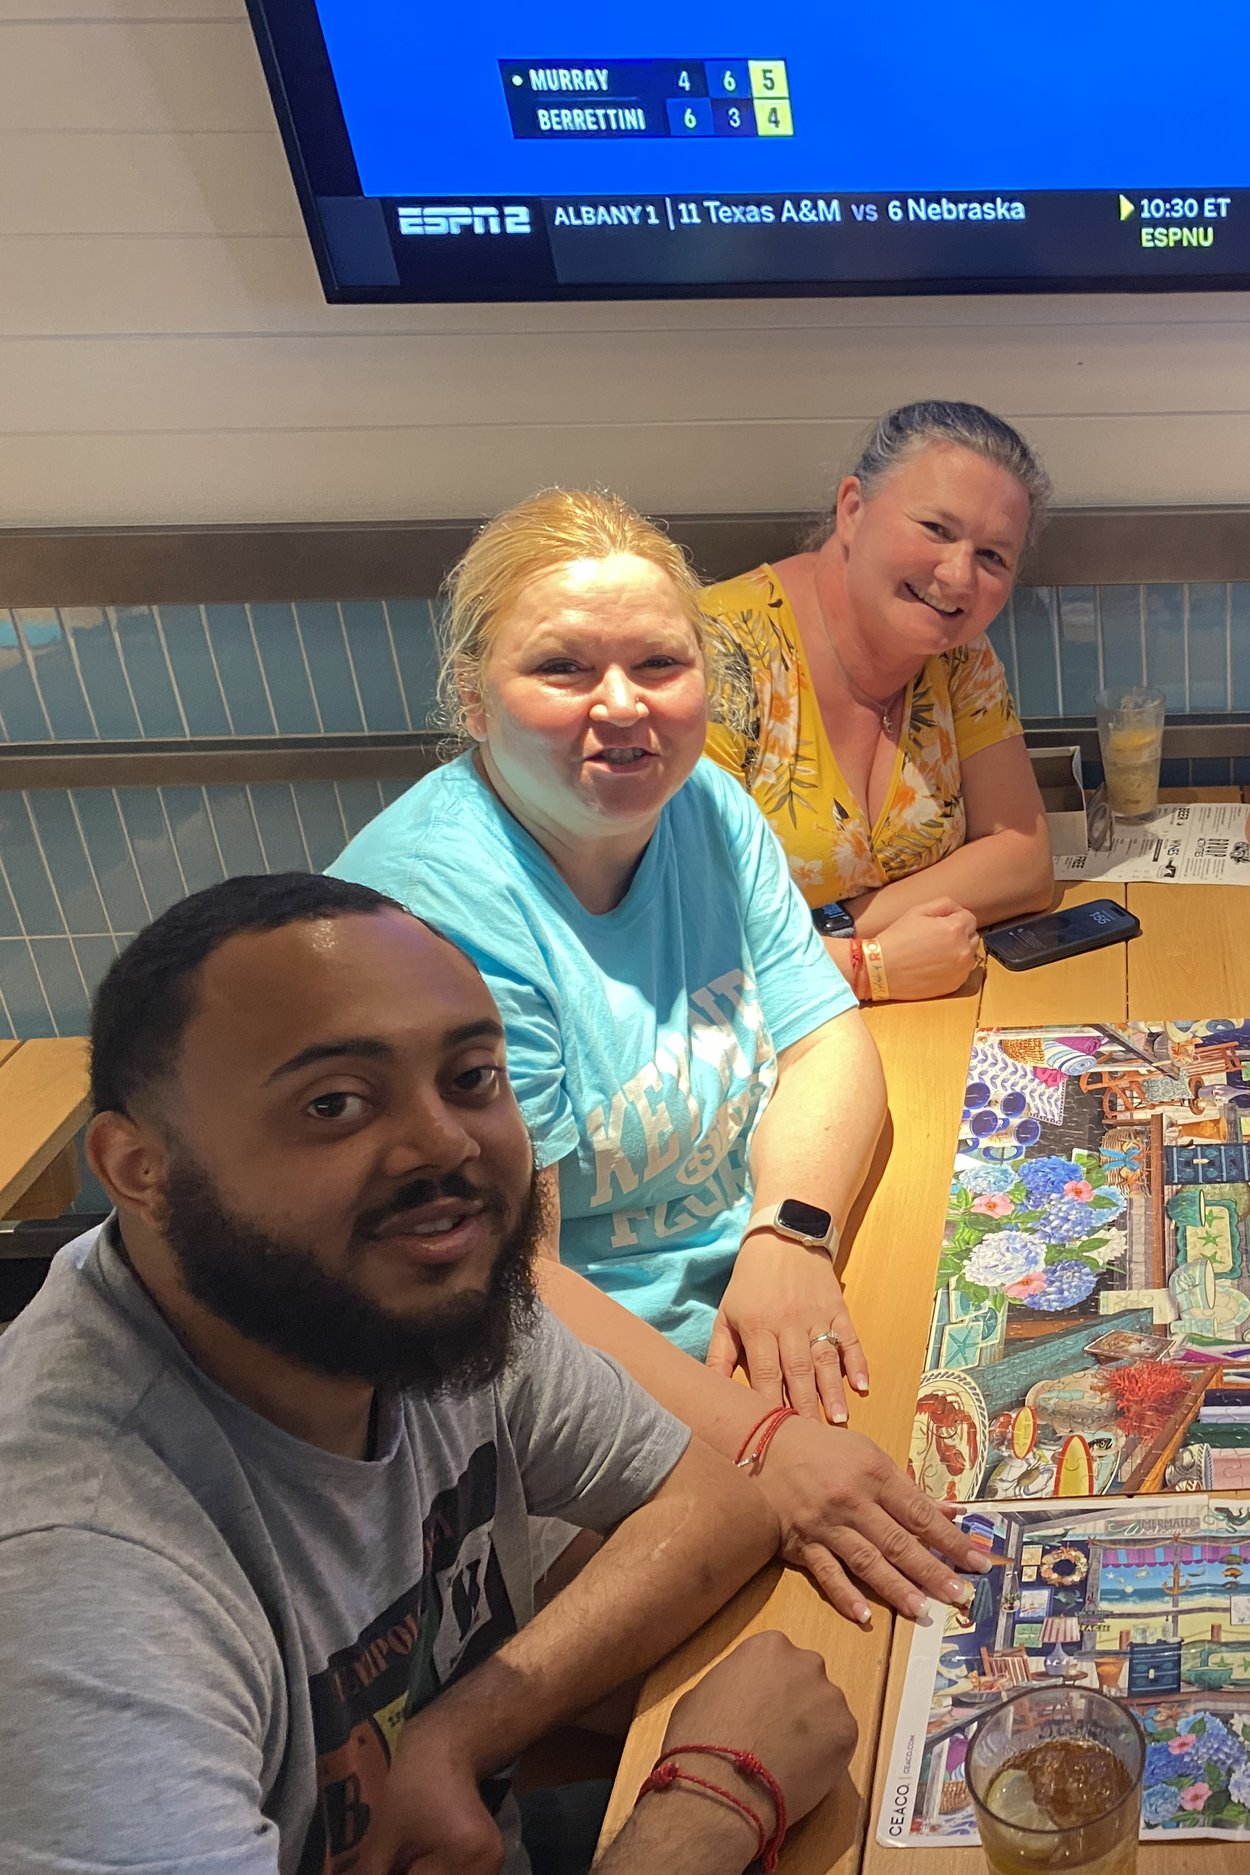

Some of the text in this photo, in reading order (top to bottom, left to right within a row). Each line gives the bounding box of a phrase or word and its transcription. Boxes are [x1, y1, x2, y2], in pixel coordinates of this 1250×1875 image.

[529, 68, 775, 91] MURRAY 4 6 5
[537, 107, 780, 130] BERRETTINI 6 3 4
[554, 197, 1026, 226] ALBANY 1 11 Texas A&M vs 6 Nebraska
[1140, 198, 1231, 219] 10:30 ET
[1141, 227, 1214, 247] ESPNU
[889, 1784, 910, 1837] CEACO
